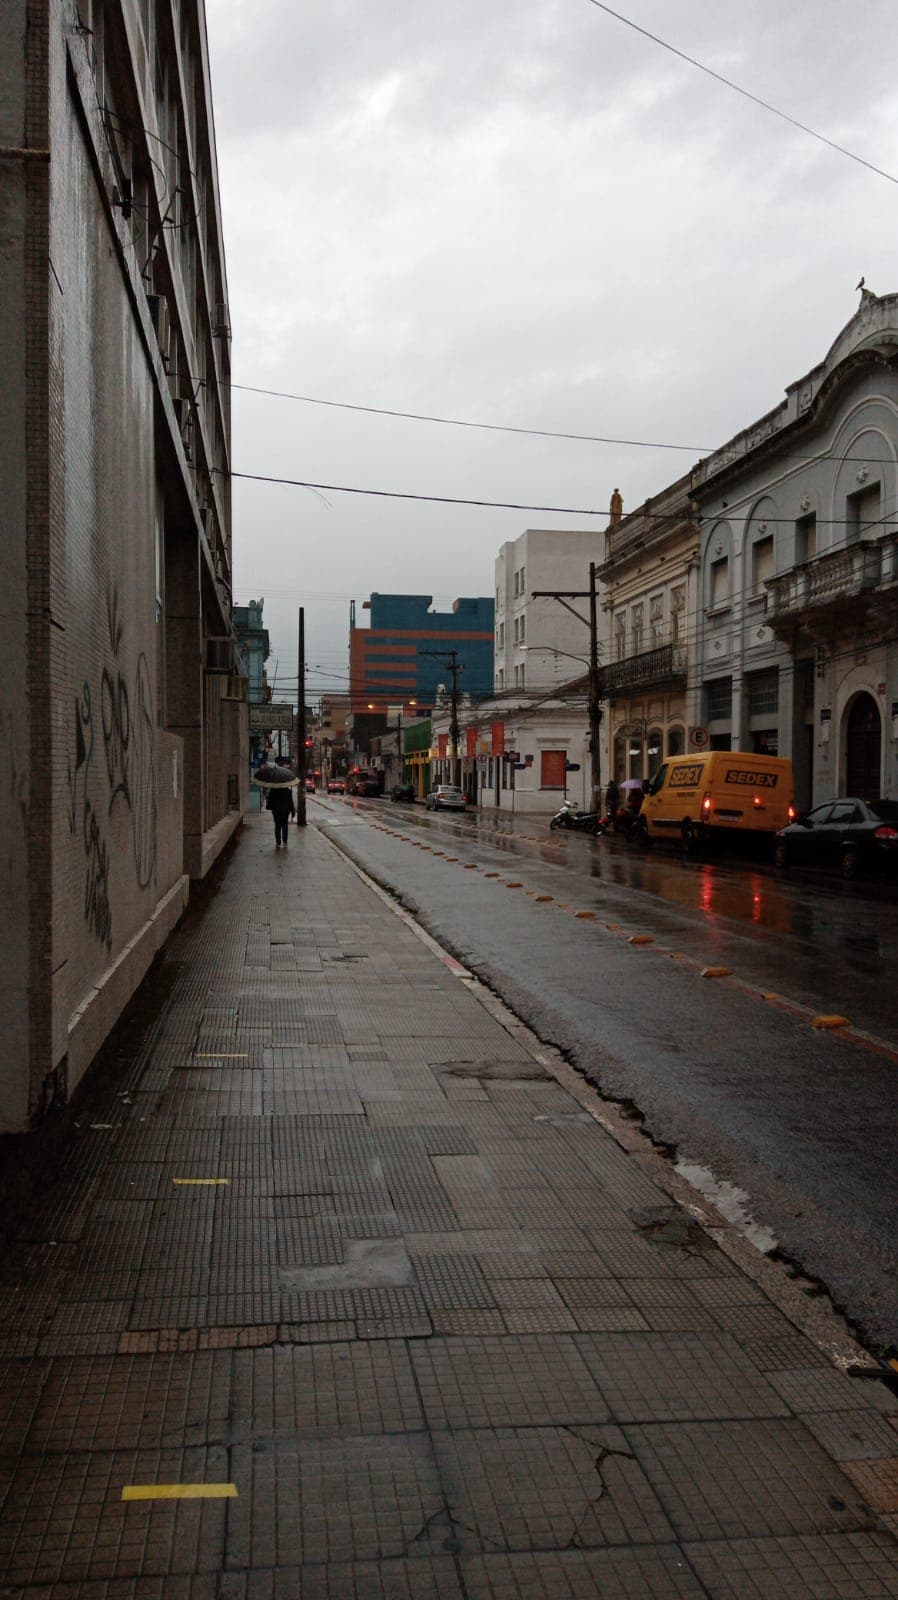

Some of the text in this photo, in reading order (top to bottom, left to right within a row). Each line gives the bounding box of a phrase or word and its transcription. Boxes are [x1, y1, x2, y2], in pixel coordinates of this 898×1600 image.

[695, 731, 703, 743] E
[671, 766, 702, 786] SEDEX
[727, 771, 776, 787] SEDEX
